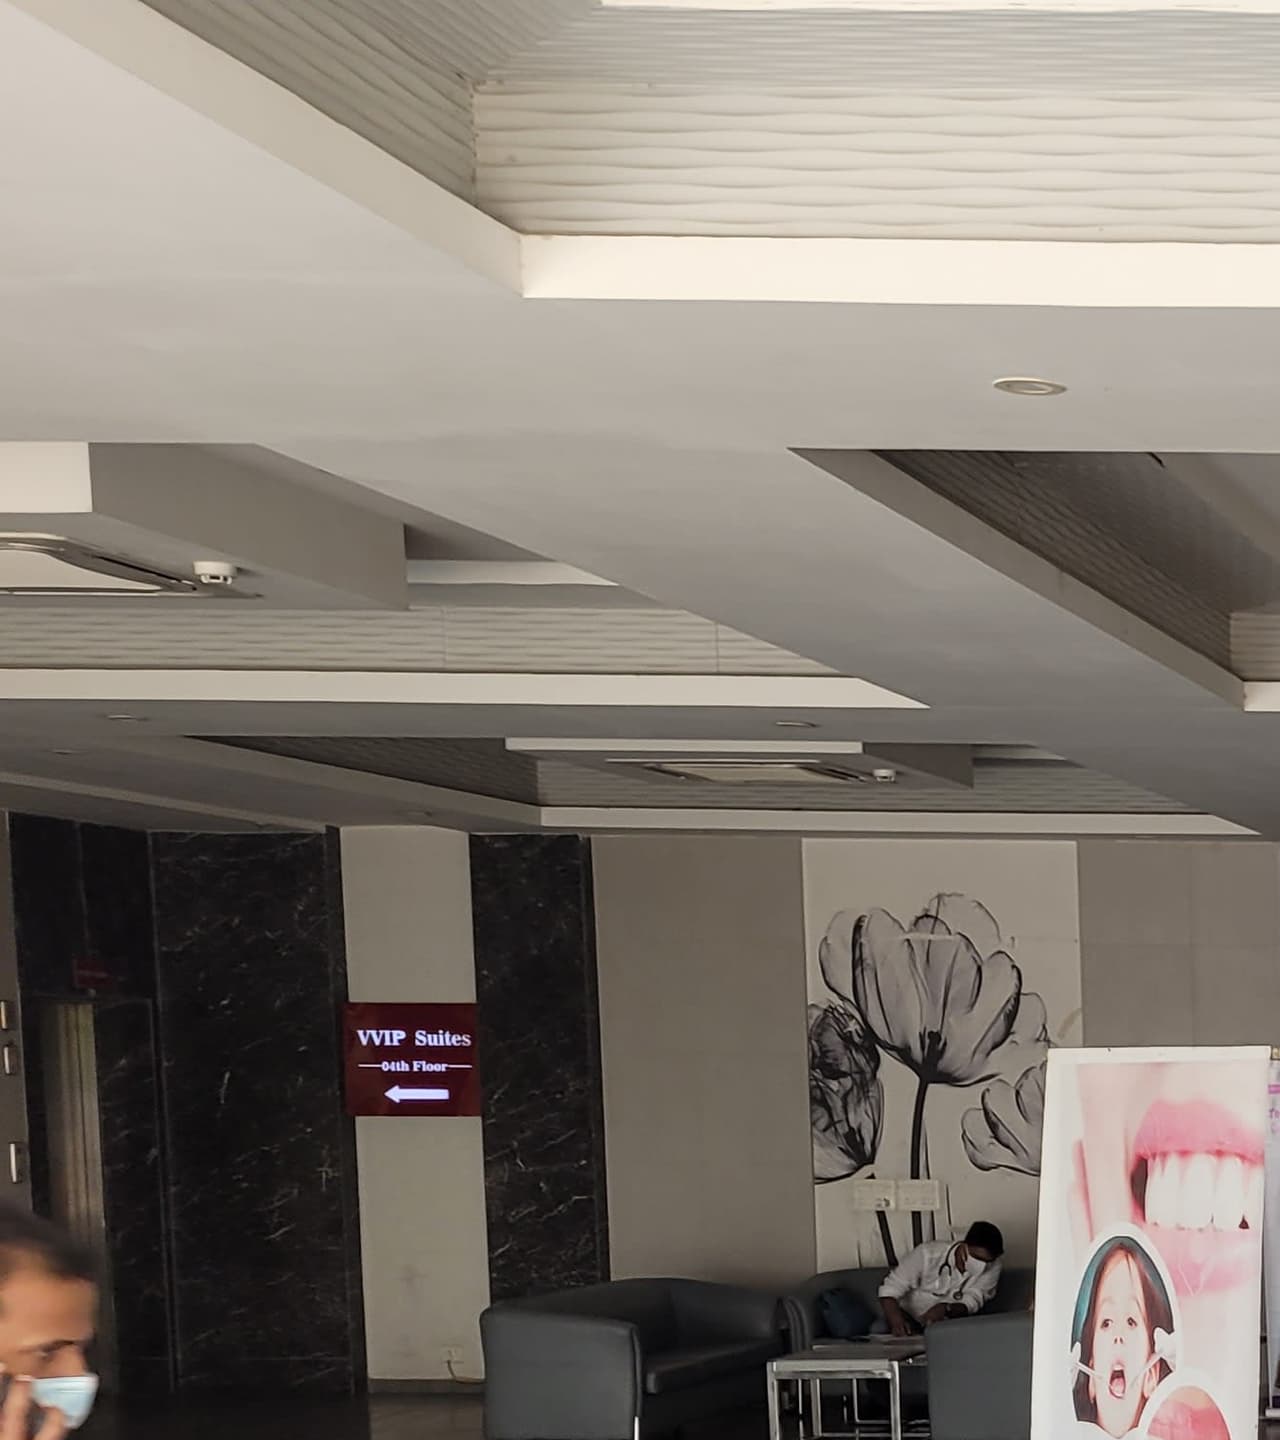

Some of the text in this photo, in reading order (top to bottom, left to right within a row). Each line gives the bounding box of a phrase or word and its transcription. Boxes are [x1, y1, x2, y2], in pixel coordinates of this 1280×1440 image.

[356, 1029, 472, 1047] VVIP Suites
[381, 1060, 448, 1072] 04th Floor
